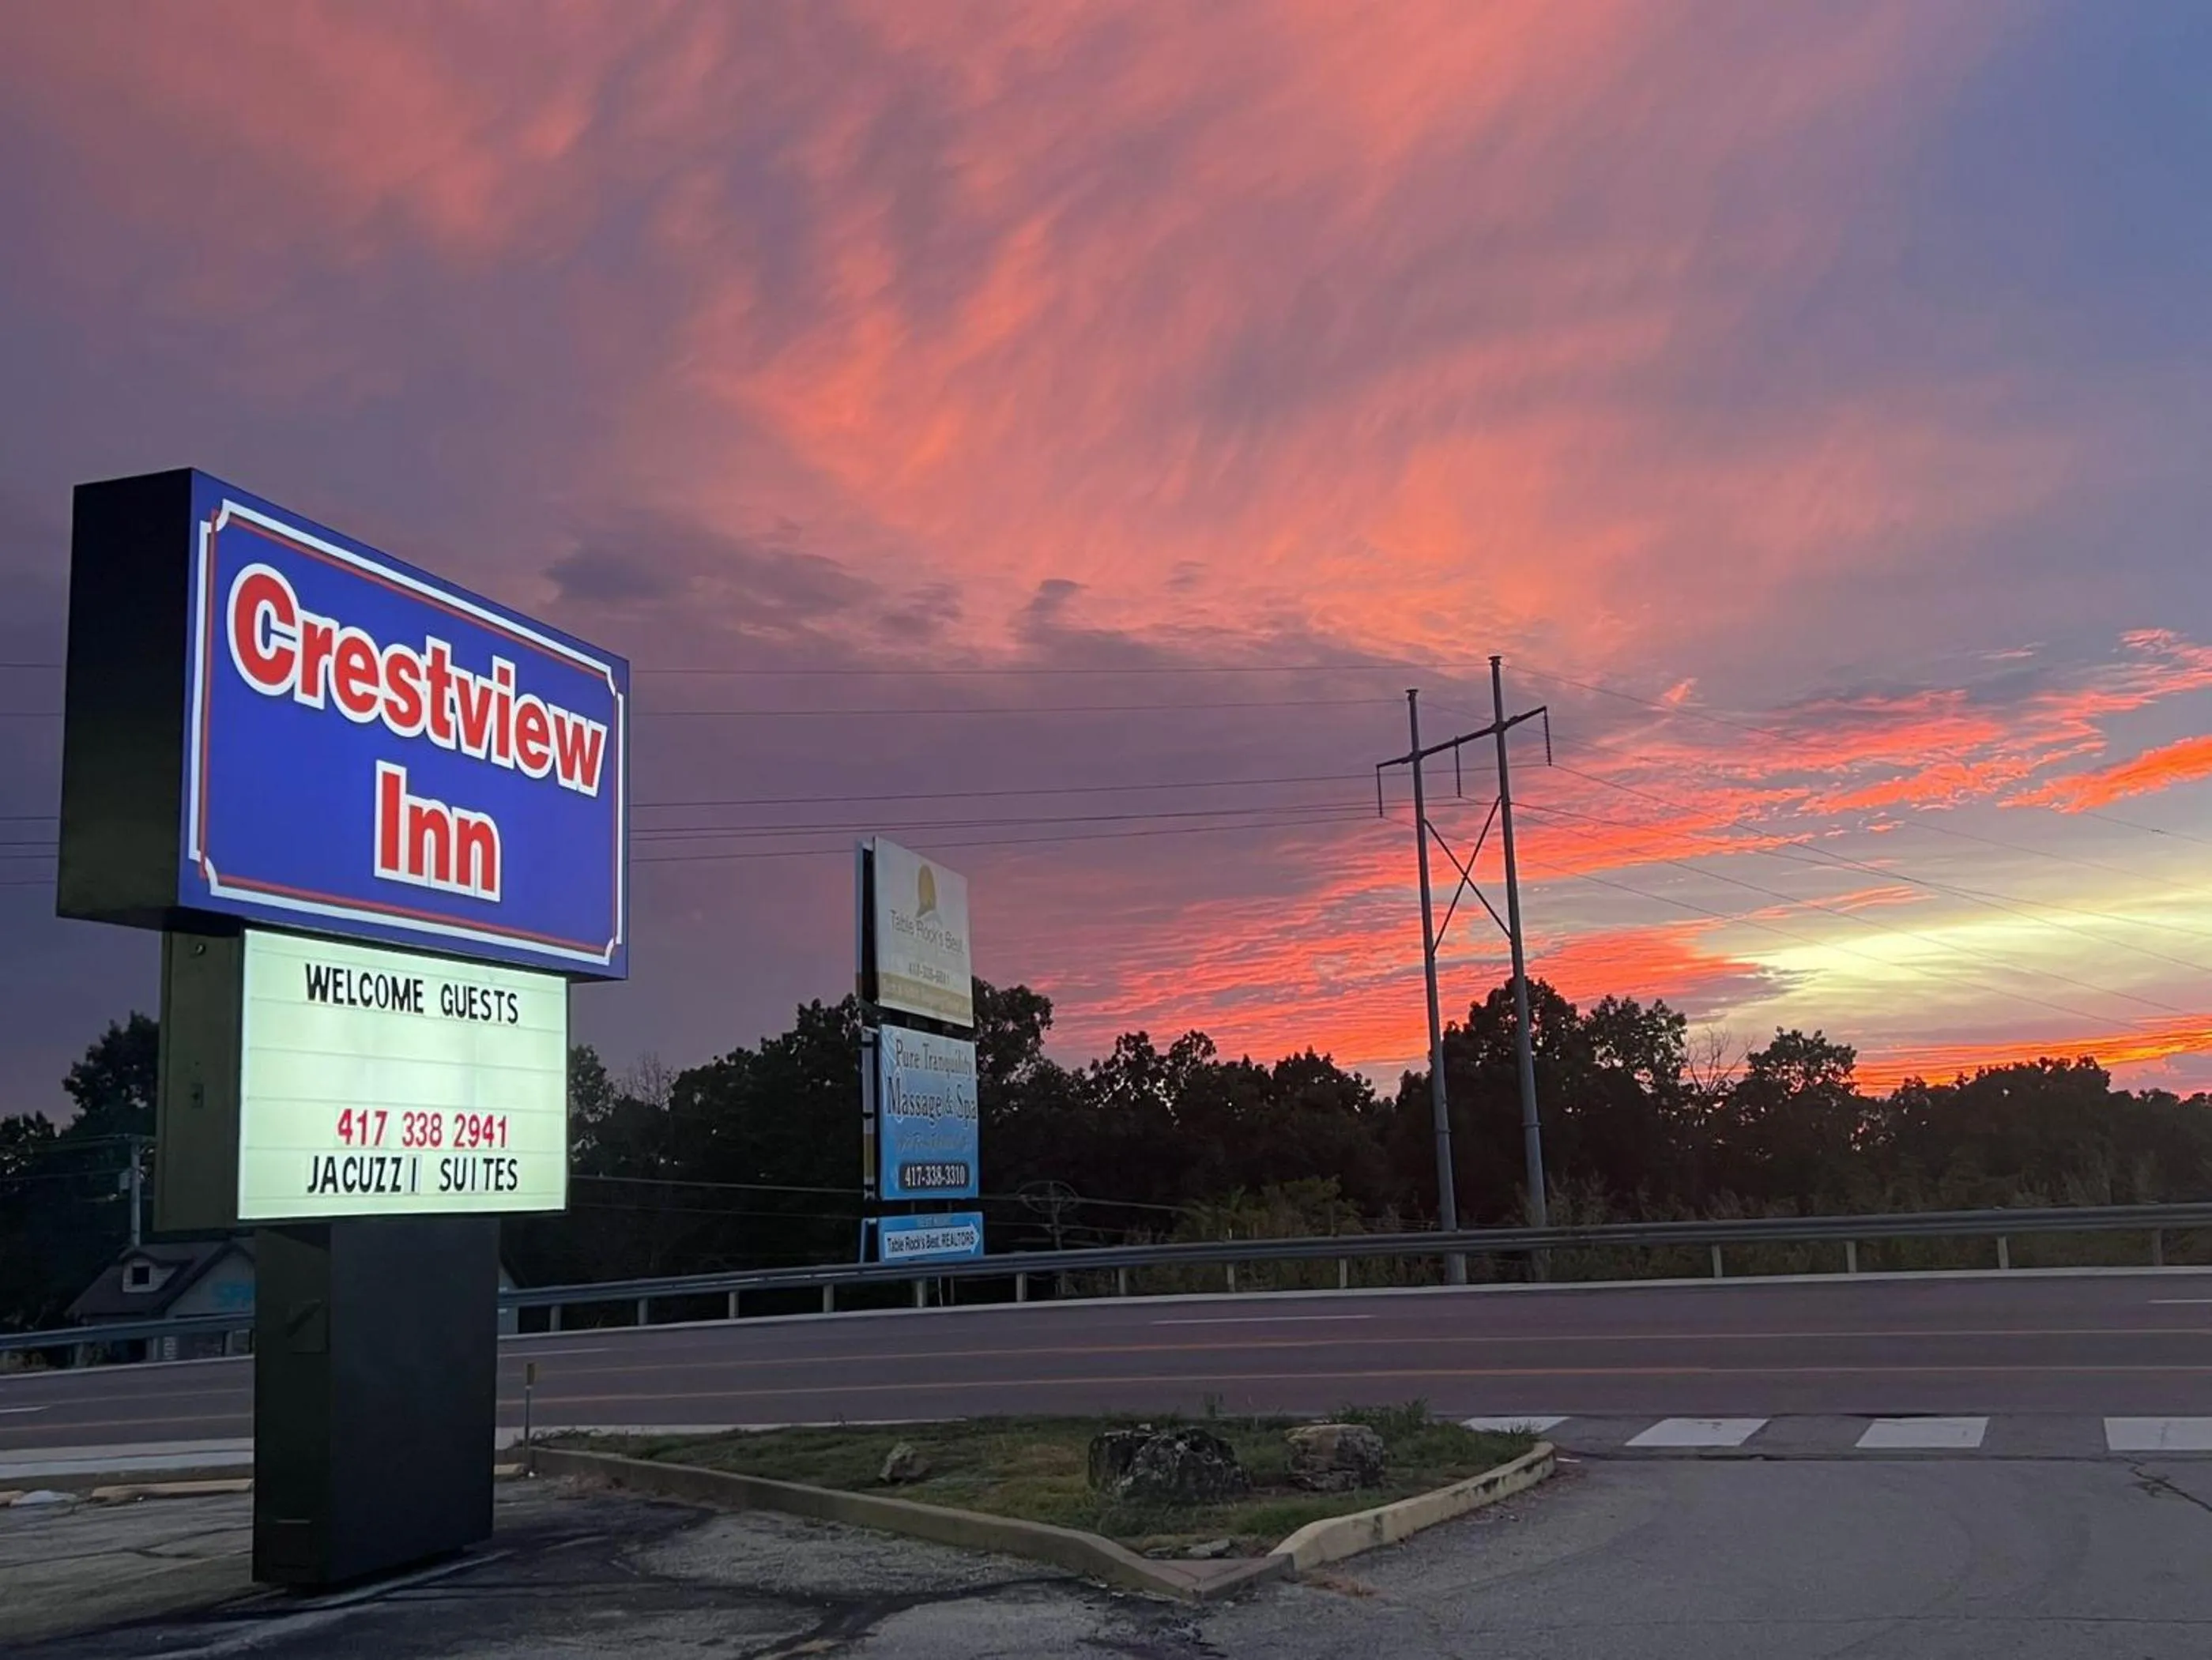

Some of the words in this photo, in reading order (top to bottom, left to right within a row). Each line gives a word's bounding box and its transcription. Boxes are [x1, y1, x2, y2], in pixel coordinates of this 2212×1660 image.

[228, 563, 608, 798] Crestview
[374, 759, 502, 902] Inn
[305, 962, 424, 1014] WELCOME
[440, 982, 519, 1025] GUESTS
[895, 1038, 921, 1070] Pure
[921, 1042, 972, 1082] Tranquility
[887, 1075, 942, 1126] Massage
[944, 1086, 954, 1116] &
[955, 1083, 978, 1127] Spa
[337, 1108, 388, 1147] 417
[401, 1111, 443, 1148] 338
[453, 1113, 508, 1149] 2941
[307, 1155, 417, 1195] JACUZZI
[439, 1157, 519, 1192] SUITES
[904, 1165, 966, 1188] 417-338-3310
